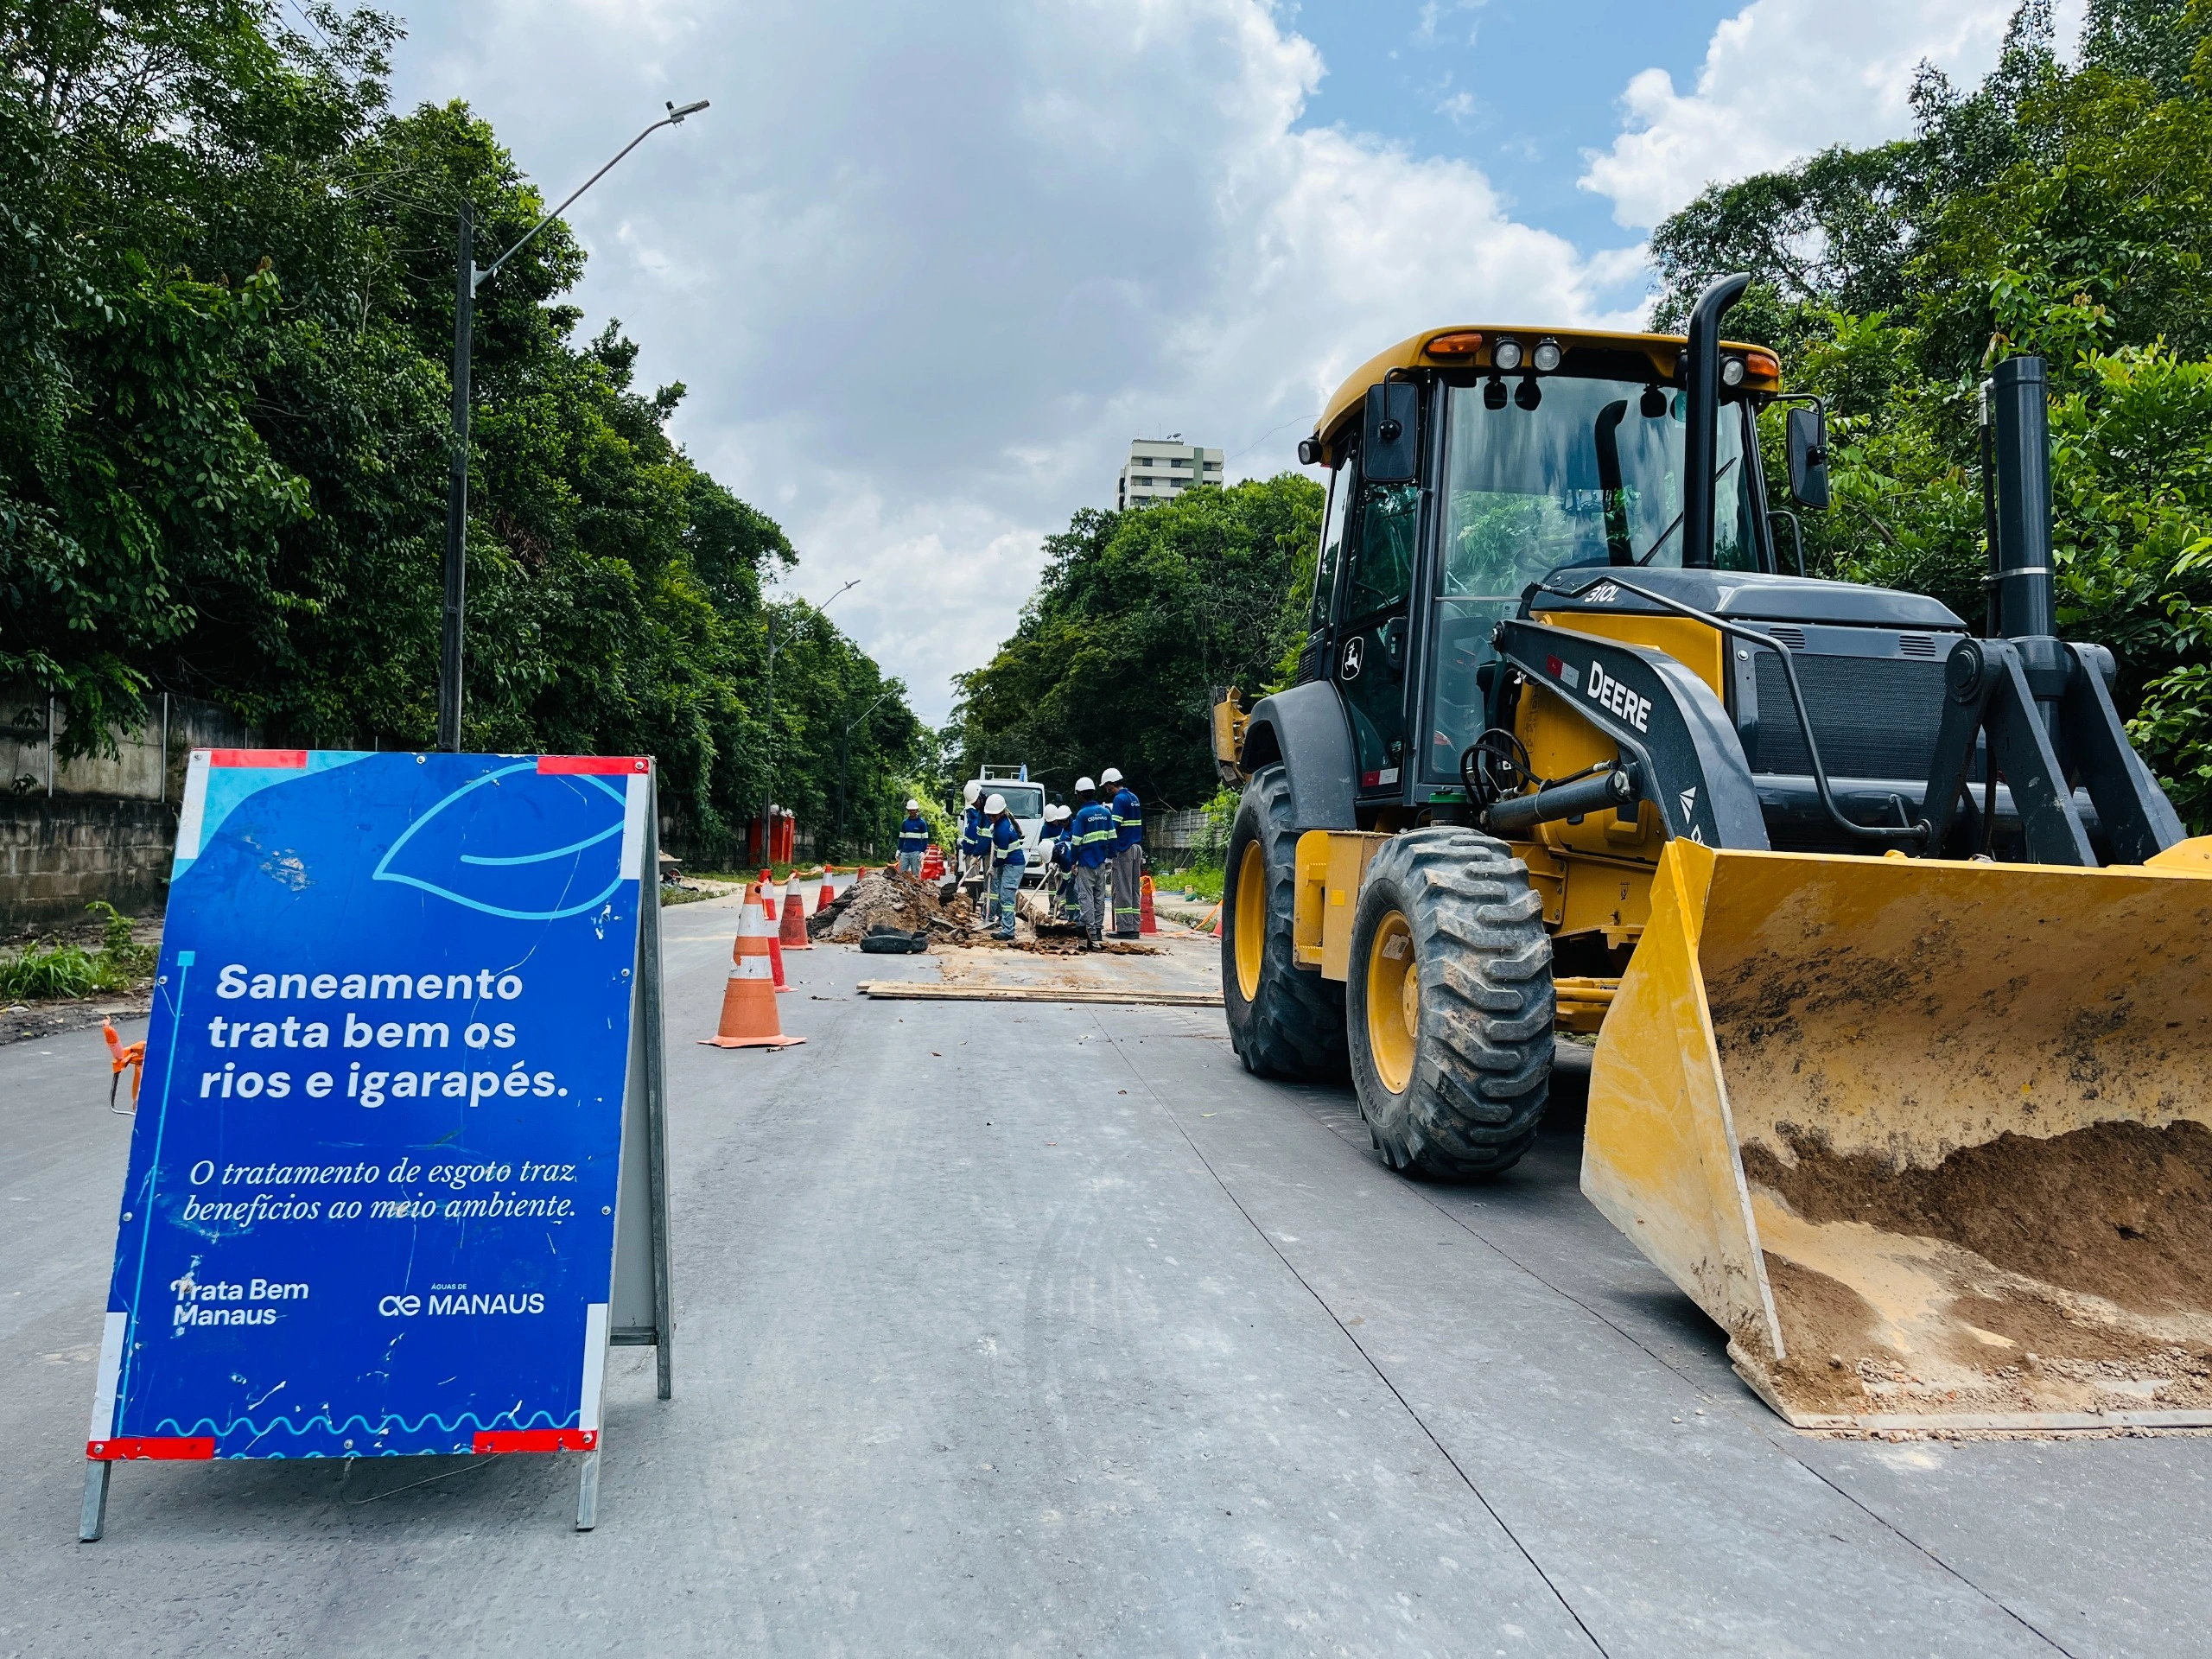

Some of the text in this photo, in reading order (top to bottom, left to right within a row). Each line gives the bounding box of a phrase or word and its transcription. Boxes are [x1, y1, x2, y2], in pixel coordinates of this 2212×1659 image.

[1585, 585, 1619, 603] 310L
[1587, 660, 1652, 734] DEERE
[217, 963, 523, 1000] Saneamento
[209, 1013, 516, 1048] trata bem os
[200, 1060, 568, 1108] rios e igarapés.
[190, 1157, 575, 1190] O tratamento de esgoto traz
[184, 1192, 575, 1227] benefícios ao meio ambiente.
[170, 1278, 309, 1301] Trata Bem
[428, 1293, 544, 1316] MANAUS
[173, 1304, 276, 1326] Manaus
